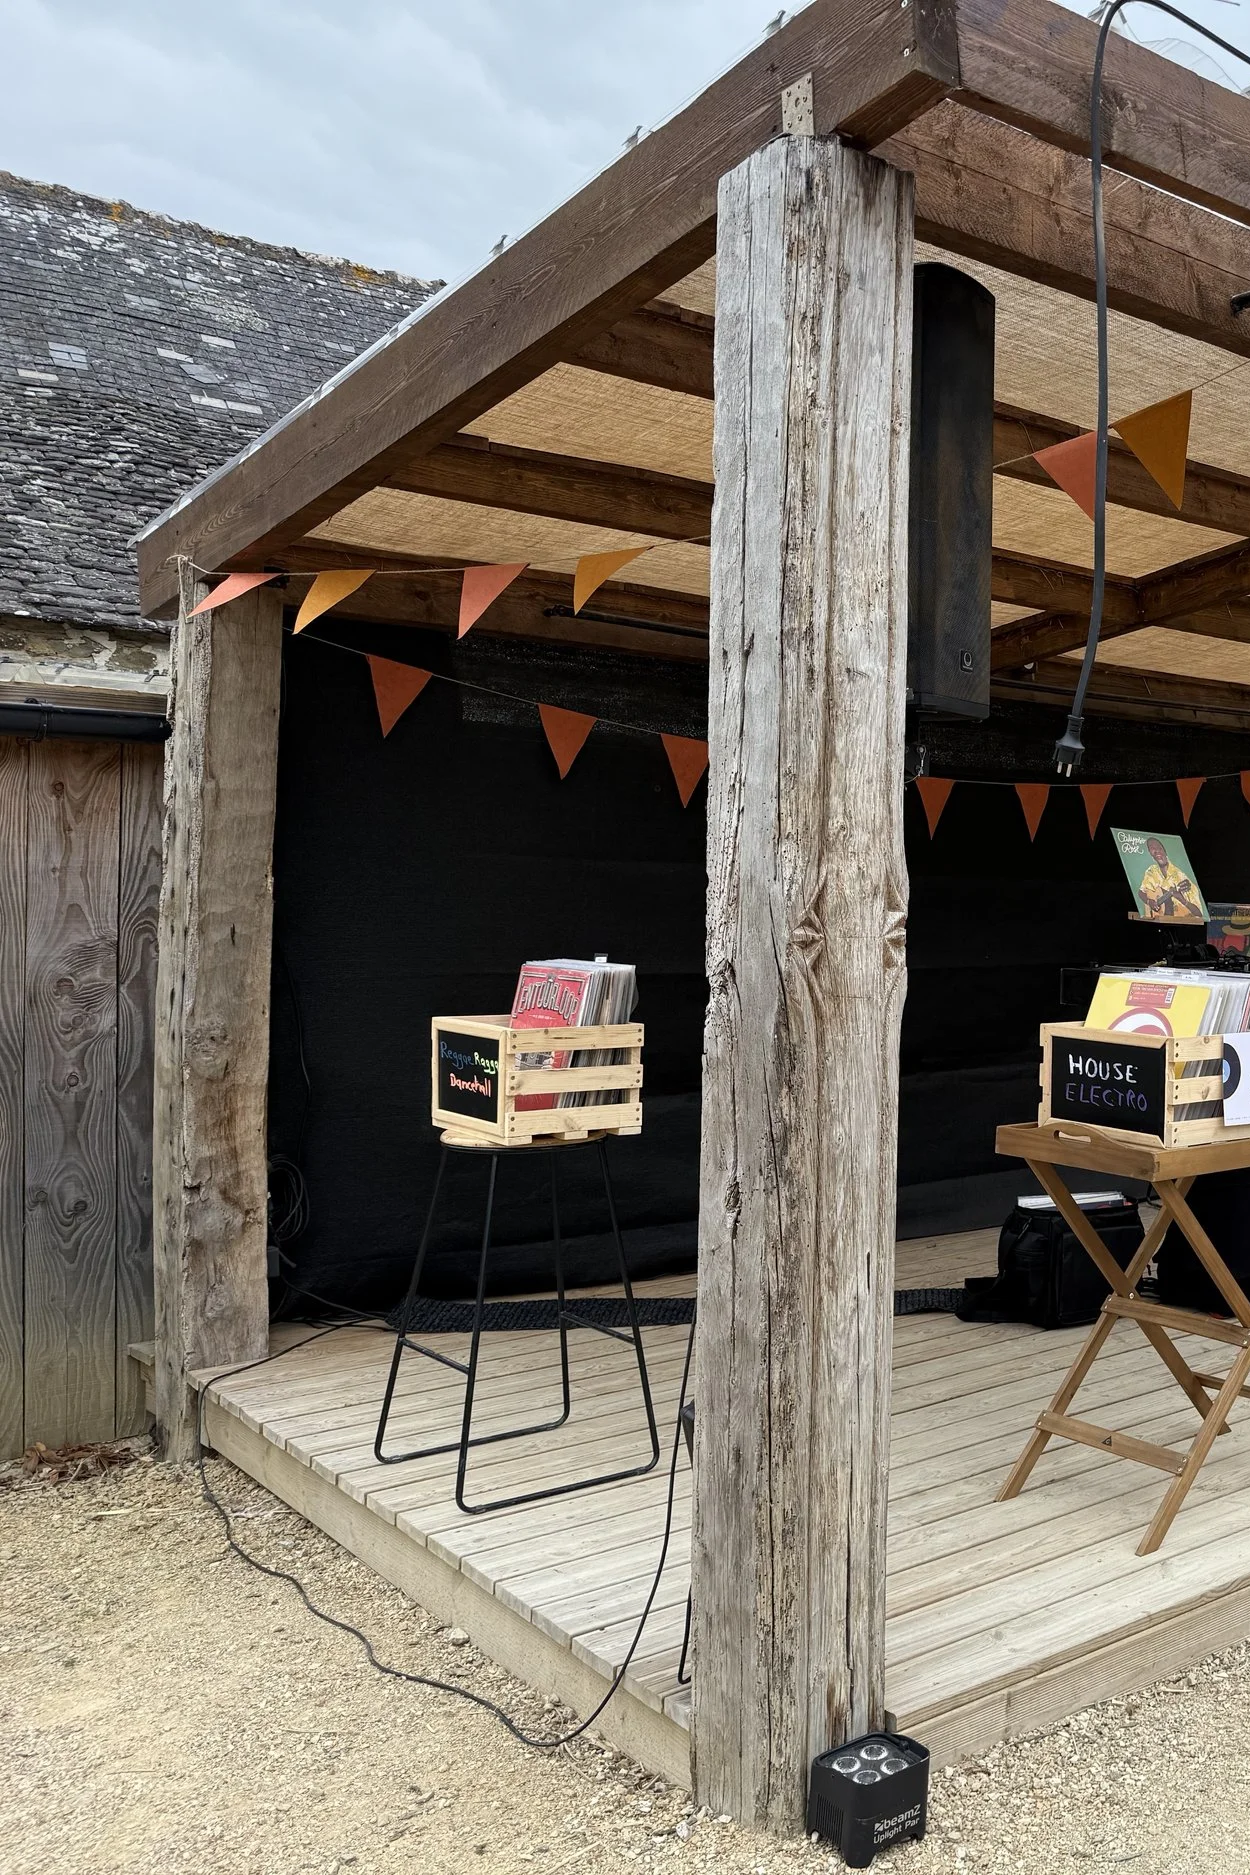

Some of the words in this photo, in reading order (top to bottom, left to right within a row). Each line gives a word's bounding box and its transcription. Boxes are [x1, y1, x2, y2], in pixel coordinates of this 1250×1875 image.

[440, 1041, 474, 1070] Reggae
[1068, 1053, 1138, 1083] HOUSE
[449, 1072, 491, 1097] Dancehall
[1065, 1082, 1148, 1112] ELECTRO
[873, 1824, 902, 1844] Uplight
[905, 1817, 920, 1830] Par
